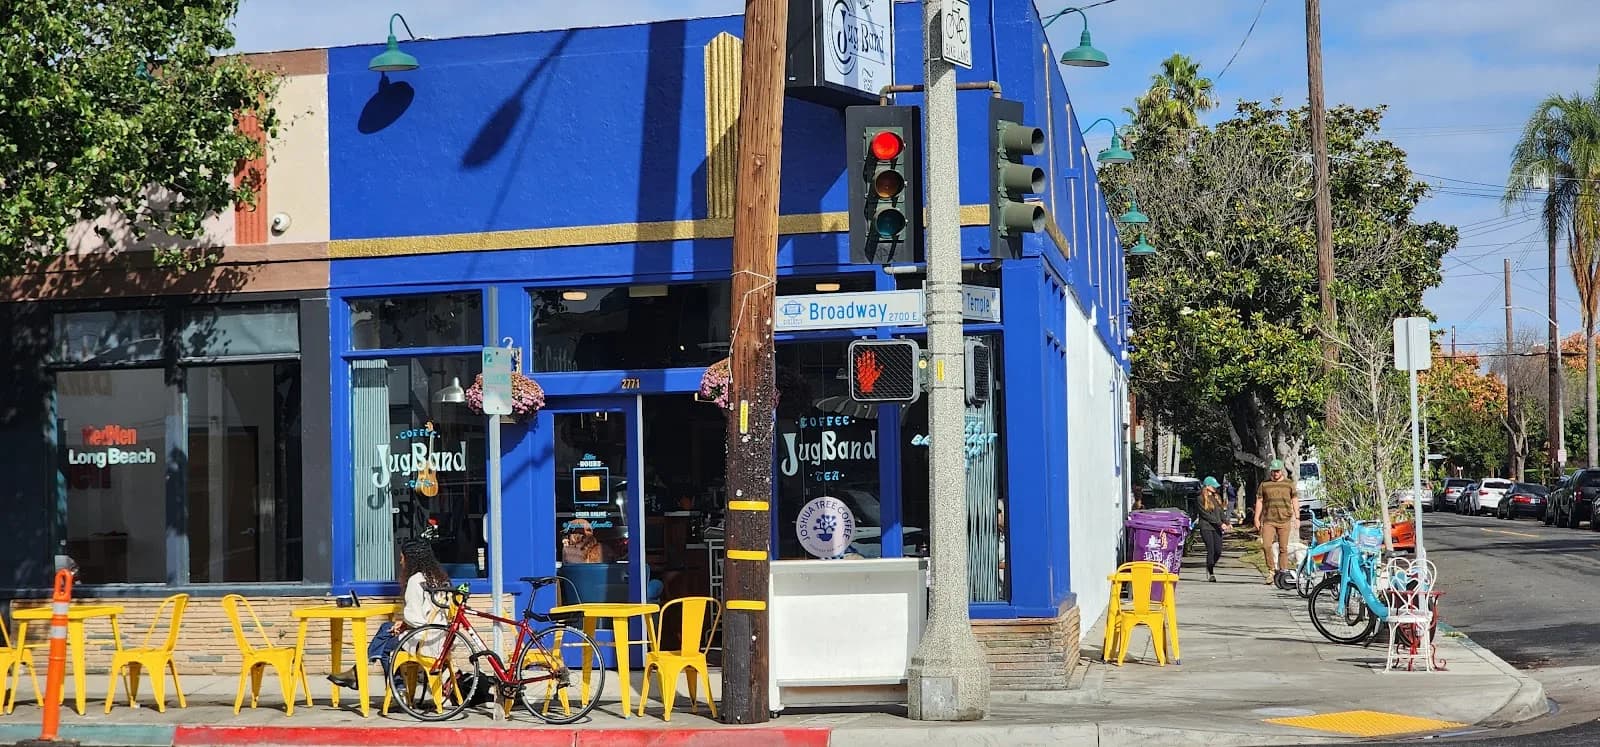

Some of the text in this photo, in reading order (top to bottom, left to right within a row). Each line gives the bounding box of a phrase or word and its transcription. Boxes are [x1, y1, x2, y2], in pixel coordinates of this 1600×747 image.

[837, 9, 884, 54] Jug Band
[809, 301, 917, 325] Broadway 2700 E
[967, 293, 990, 316] Temple
[621, 378, 640, 390] 2771
[799, 415, 850, 428] COFFEE
[68, 447, 156, 468] Long Beach
[815, 470, 840, 481] TEA
[800, 500, 852, 541] JOSHUA TREE COFFEE
